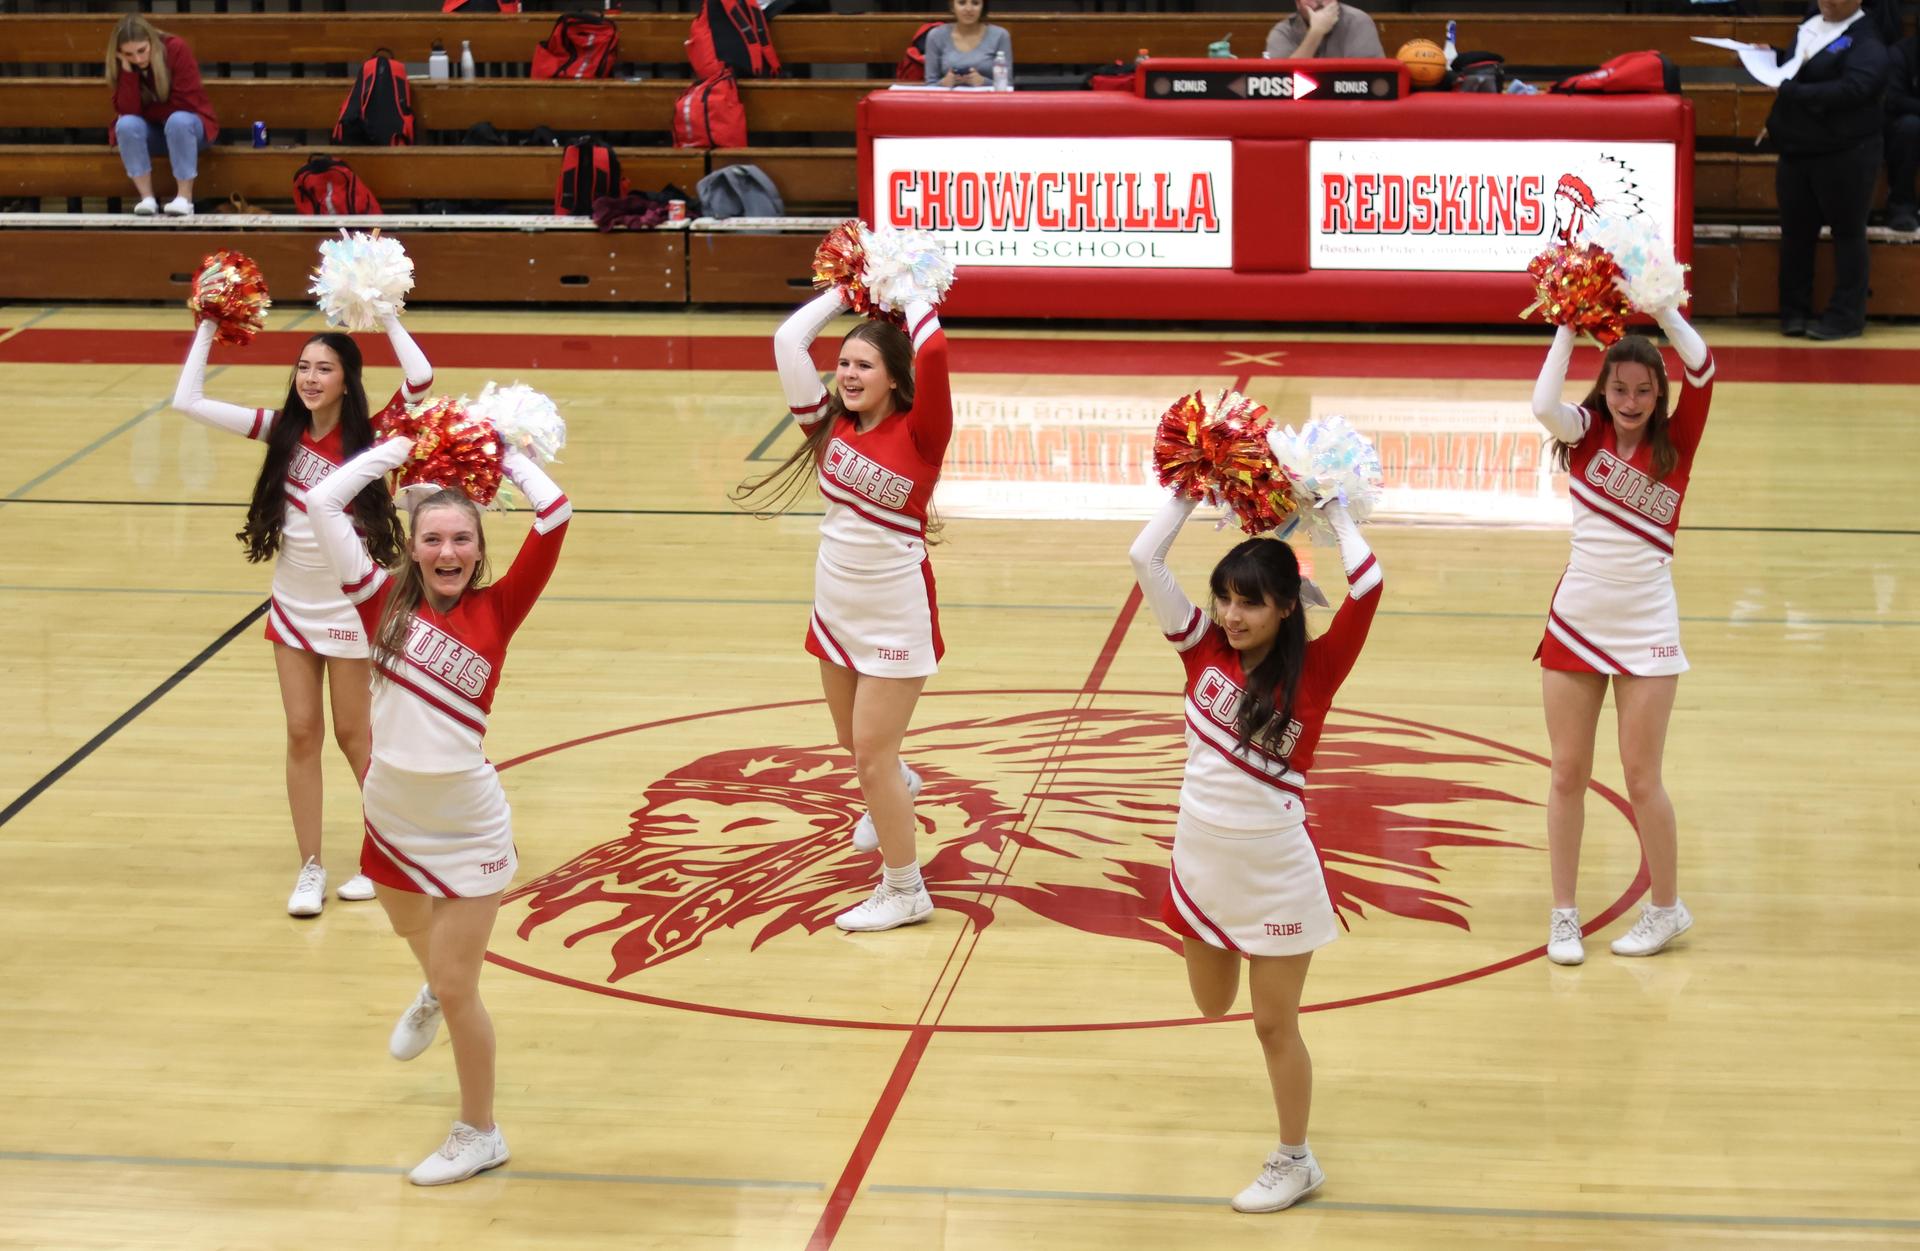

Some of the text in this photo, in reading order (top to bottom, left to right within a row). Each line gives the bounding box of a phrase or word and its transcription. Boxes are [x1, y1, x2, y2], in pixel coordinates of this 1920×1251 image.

[1172, 79, 1207, 93] BONUS
[1247, 77, 1294, 96] POSS
[1334, 80, 1368, 93] BONUS
[887, 169, 1221, 236] CHOWCHILLA
[1320, 172, 1545, 237] REDSKINS
[942, 240, 1165, 258] HIGH SCHOOL
[287, 441, 341, 490] UH
[823, 438, 914, 510] CUHS
[1585, 448, 1681, 525] CUHS
[327, 628, 359, 643] TRIBE
[877, 648, 910, 661] TRIBE
[1650, 645, 1679, 659] TRIBE
[480, 856, 509, 876] TRIBE
[1264, 922, 1303, 937] TRIBE
